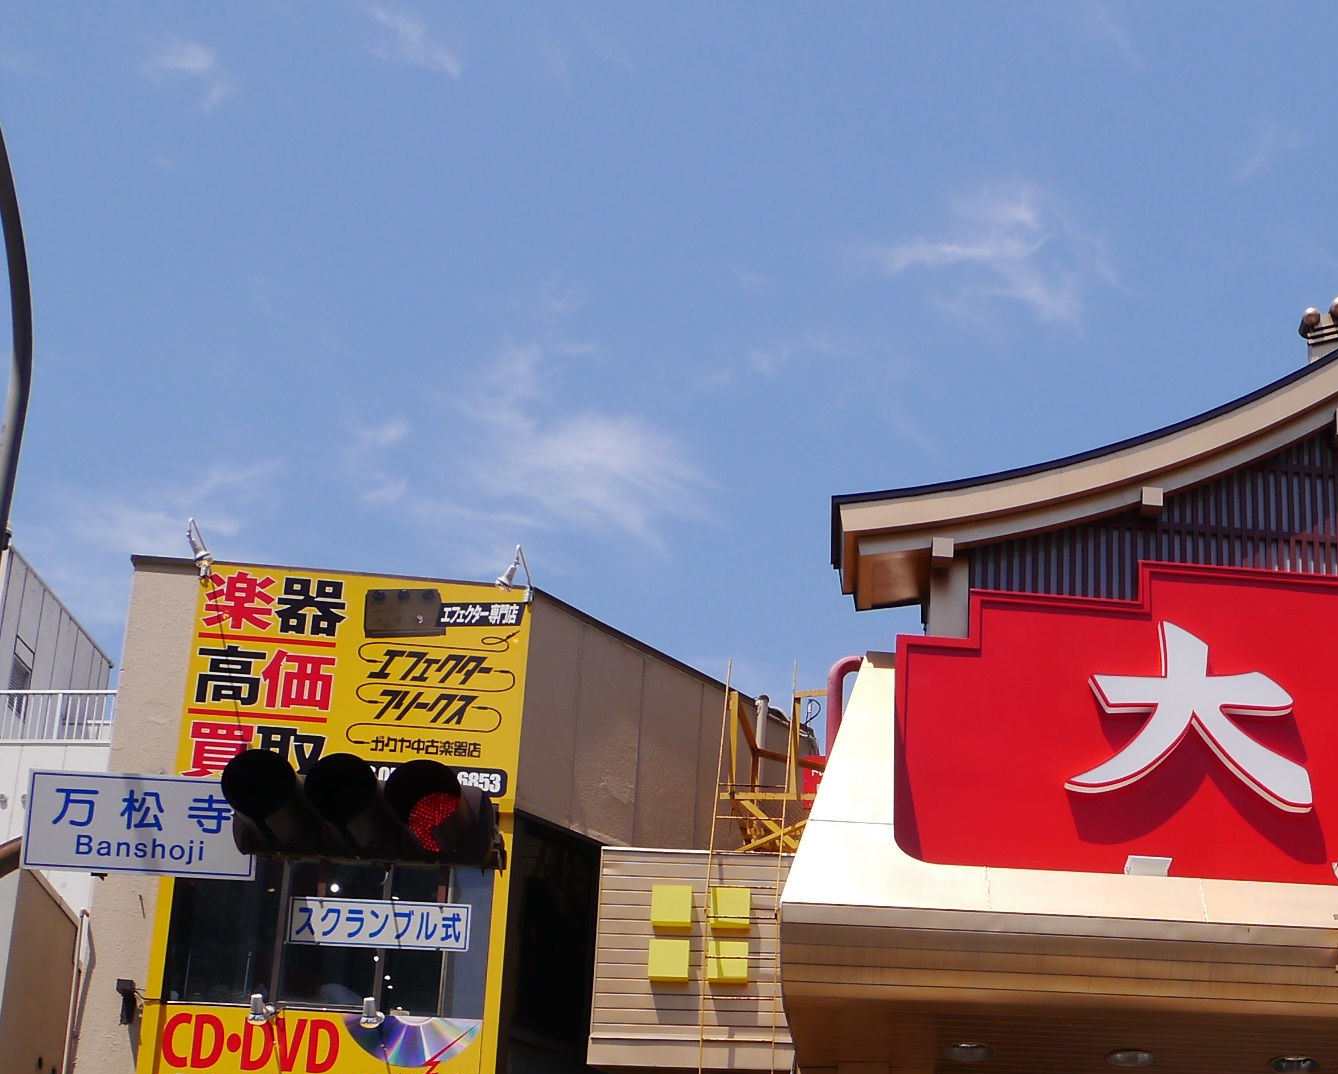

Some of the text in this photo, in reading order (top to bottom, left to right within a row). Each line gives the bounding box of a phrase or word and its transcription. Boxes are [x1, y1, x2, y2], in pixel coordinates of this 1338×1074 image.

[201, 571, 346, 637] 楽器
[441, 603, 519, 626] エフェクター専門店
[195, 645, 336, 711] 高価
[367, 649, 493, 686] エフェクター
[372, 688, 480, 725] フリークス
[180, 721, 327, 778] 買取
[369, 736, 482, 758] ガクヤ中古楽器店
[52, 787, 233, 834] 万松寺
[75, 835, 205, 863] Banshoji
[295, 906, 462, 944] スクランブル式
